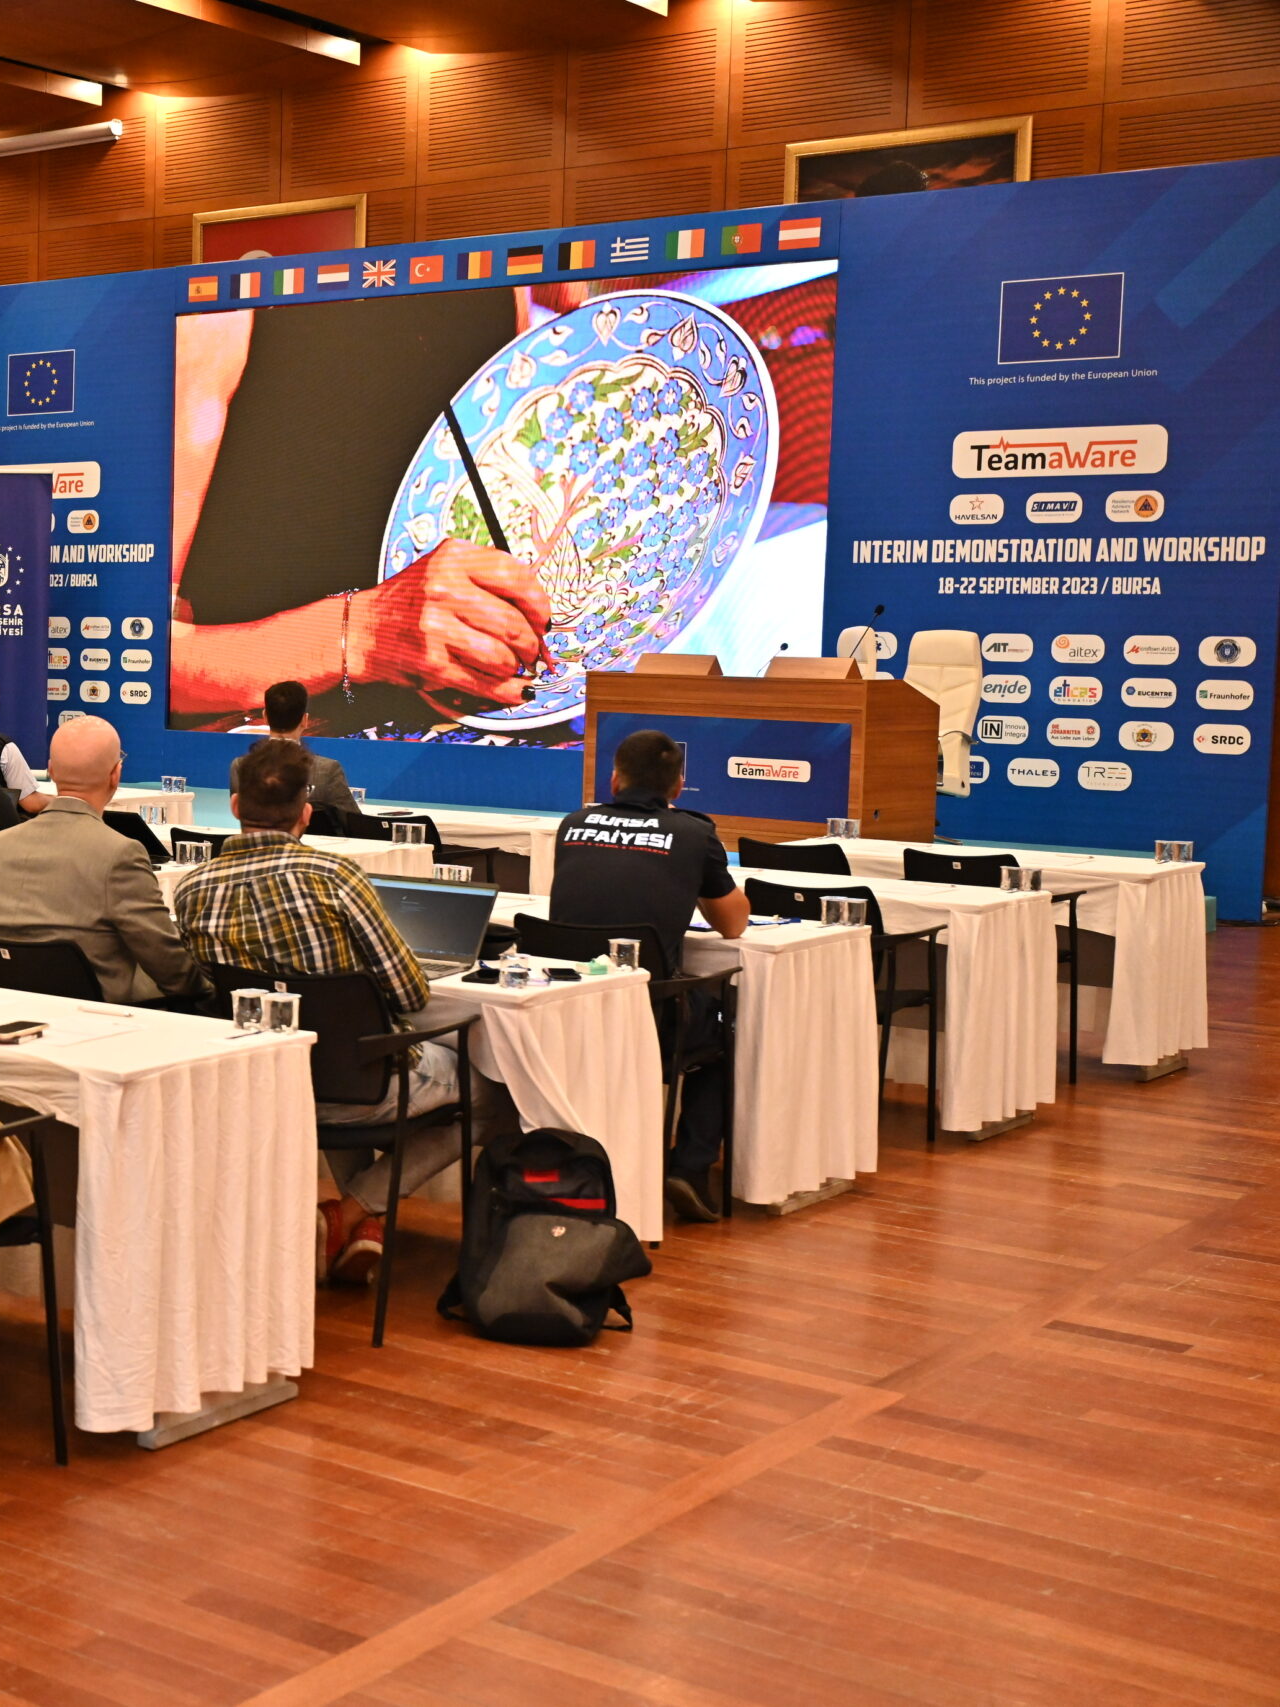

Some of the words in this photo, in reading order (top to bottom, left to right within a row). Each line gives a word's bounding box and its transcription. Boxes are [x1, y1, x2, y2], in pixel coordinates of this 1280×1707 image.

[969, 377, 985, 386] This
[987, 375, 1017, 387] project
[1018, 375, 1025, 383] is
[1026, 373, 1057, 383] funded
[1059, 373, 1070, 384] by
[1072, 371, 1086, 380] the
[1087, 369, 1129, 381] European
[1131, 368, 1158, 377] Union
[1, 425, 18, 433] project
[23, 423, 40, 431] funded
[56, 420, 79, 429] European
[1032, 501, 1076, 511] SIMAVI
[954, 513, 998, 521] HAVELSAN
[62, 544, 85, 563] AND
[87, 543, 155, 562] WORKSHOP
[852, 539, 928, 563] INTERIM
[931, 537, 1092, 563] DEMONSTRATION
[1095, 537, 1138, 562] AND
[1143, 536, 1266, 562] WORKSHOP
[64, 574, 70, 587] /
[70, 573, 98, 587] BURSA
[937, 577, 977, 594] 18-22
[978, 577, 1060, 594] SEPTEMBER
[1062, 577, 1098, 594] 2023
[1100, 577, 1110, 594] /
[1111, 577, 1162, 594] BURSA
[50, 626, 67, 634] aitex
[985, 642, 1009, 652] AIT
[1068, 647, 1099, 658] aitex
[48, 650, 68, 664] ticas
[983, 680, 1027, 697] enide
[1053, 679, 1098, 698] eticas
[1209, 692, 1250, 700] Fraunhofer
[983, 722, 1001, 737] IN
[1004, 731, 1027, 739] Integra
[1211, 735, 1244, 745] SRDC
[1009, 768, 1057, 777] THALES
[584, 813, 660, 829] BURSA
[564, 826, 674, 850] İTFAİYESİ
